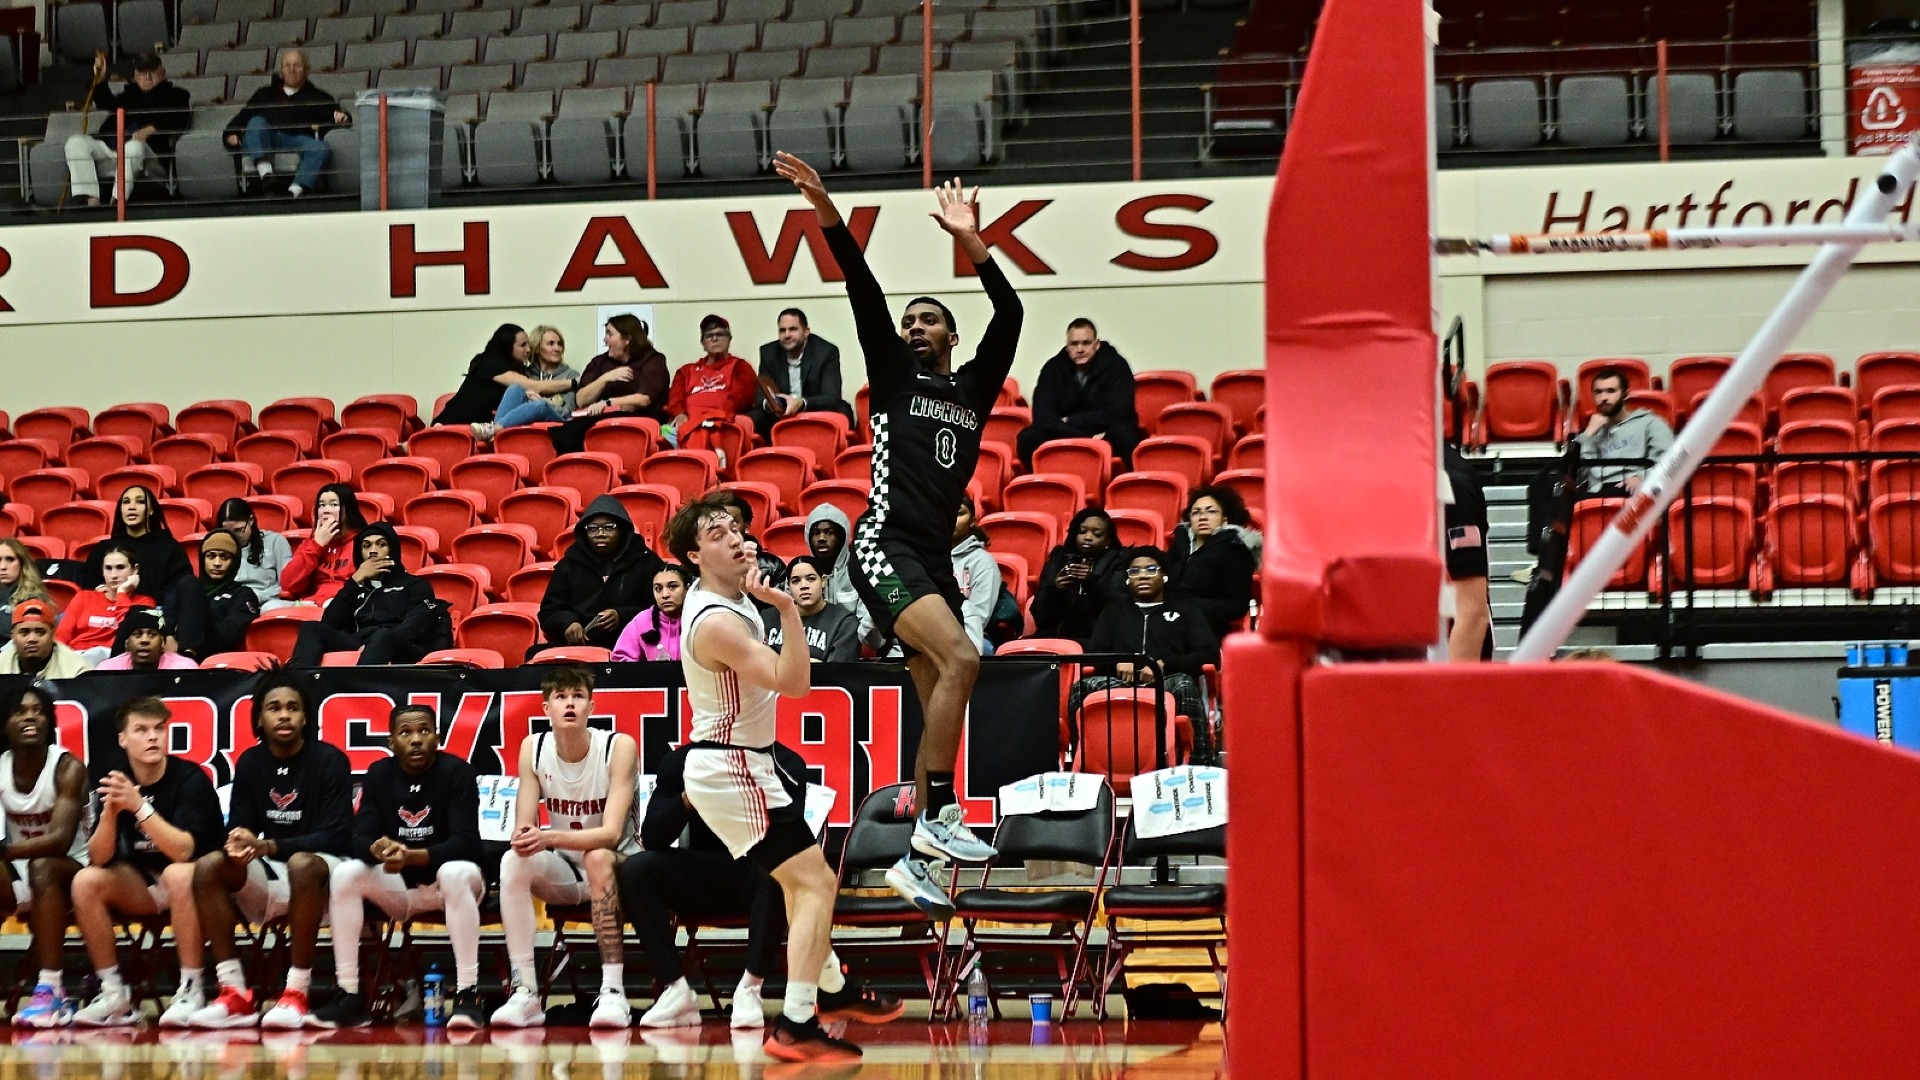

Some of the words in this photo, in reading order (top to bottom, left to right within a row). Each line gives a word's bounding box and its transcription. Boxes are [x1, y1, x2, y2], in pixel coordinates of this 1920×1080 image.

[1536, 176, 1860, 253] Hartford
[0, 233, 191, 312] D
[388, 193, 1220, 299] HAWKS
[910, 395, 979, 431] NICHOLS
[935, 428, 957, 469] 0
[768, 625, 828, 652] CAINA
[150, 685, 998, 828] BSKETALL
